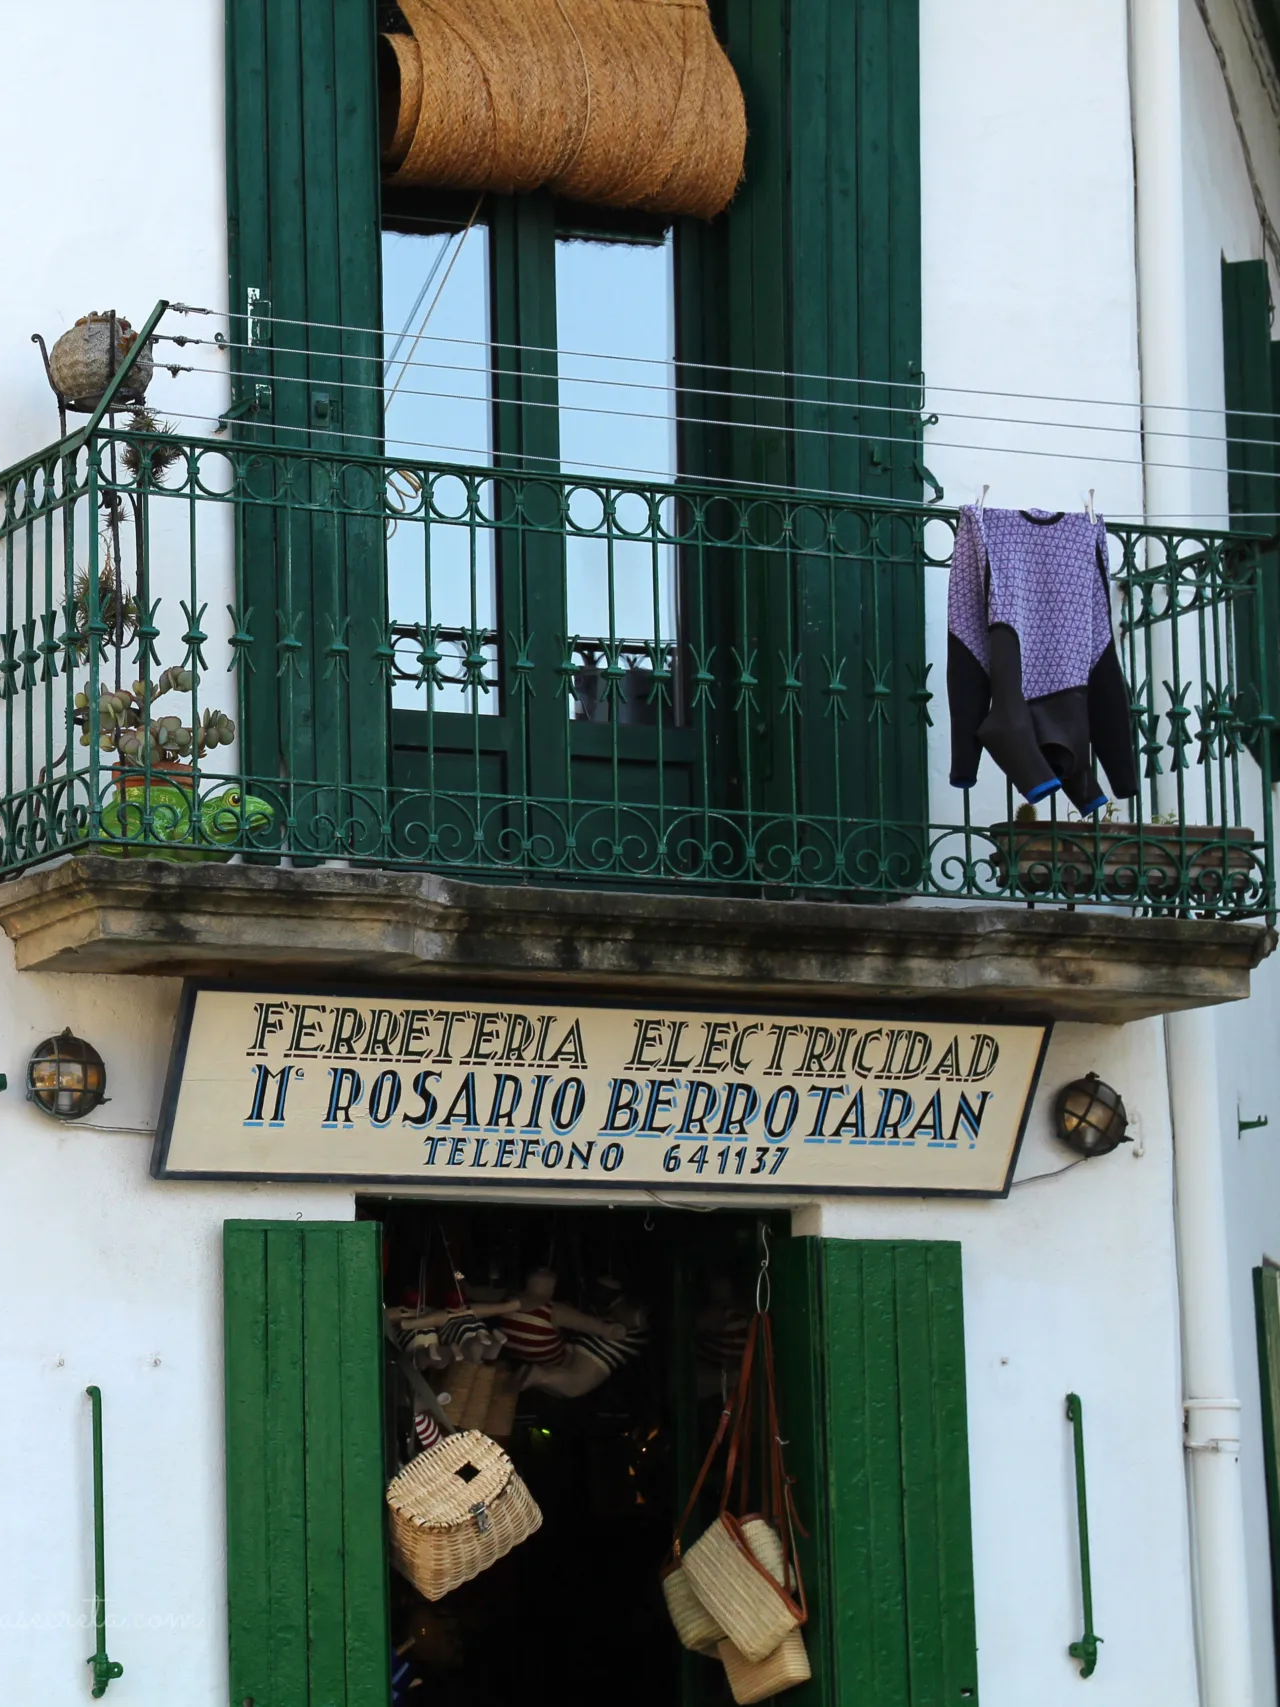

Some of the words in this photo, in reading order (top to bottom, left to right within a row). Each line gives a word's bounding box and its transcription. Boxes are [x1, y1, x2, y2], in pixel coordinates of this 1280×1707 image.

[246, 1001, 588, 1069] FERRETERIA
[624, 1018, 1000, 1083] ELECTRICIDAD
[321, 1067, 586, 1136] ROSARIO
[597, 1077, 995, 1149] BERROTARAN
[423, 1136, 624, 1172] TELEFONO
[662, 1144, 790, 1175] 641137
